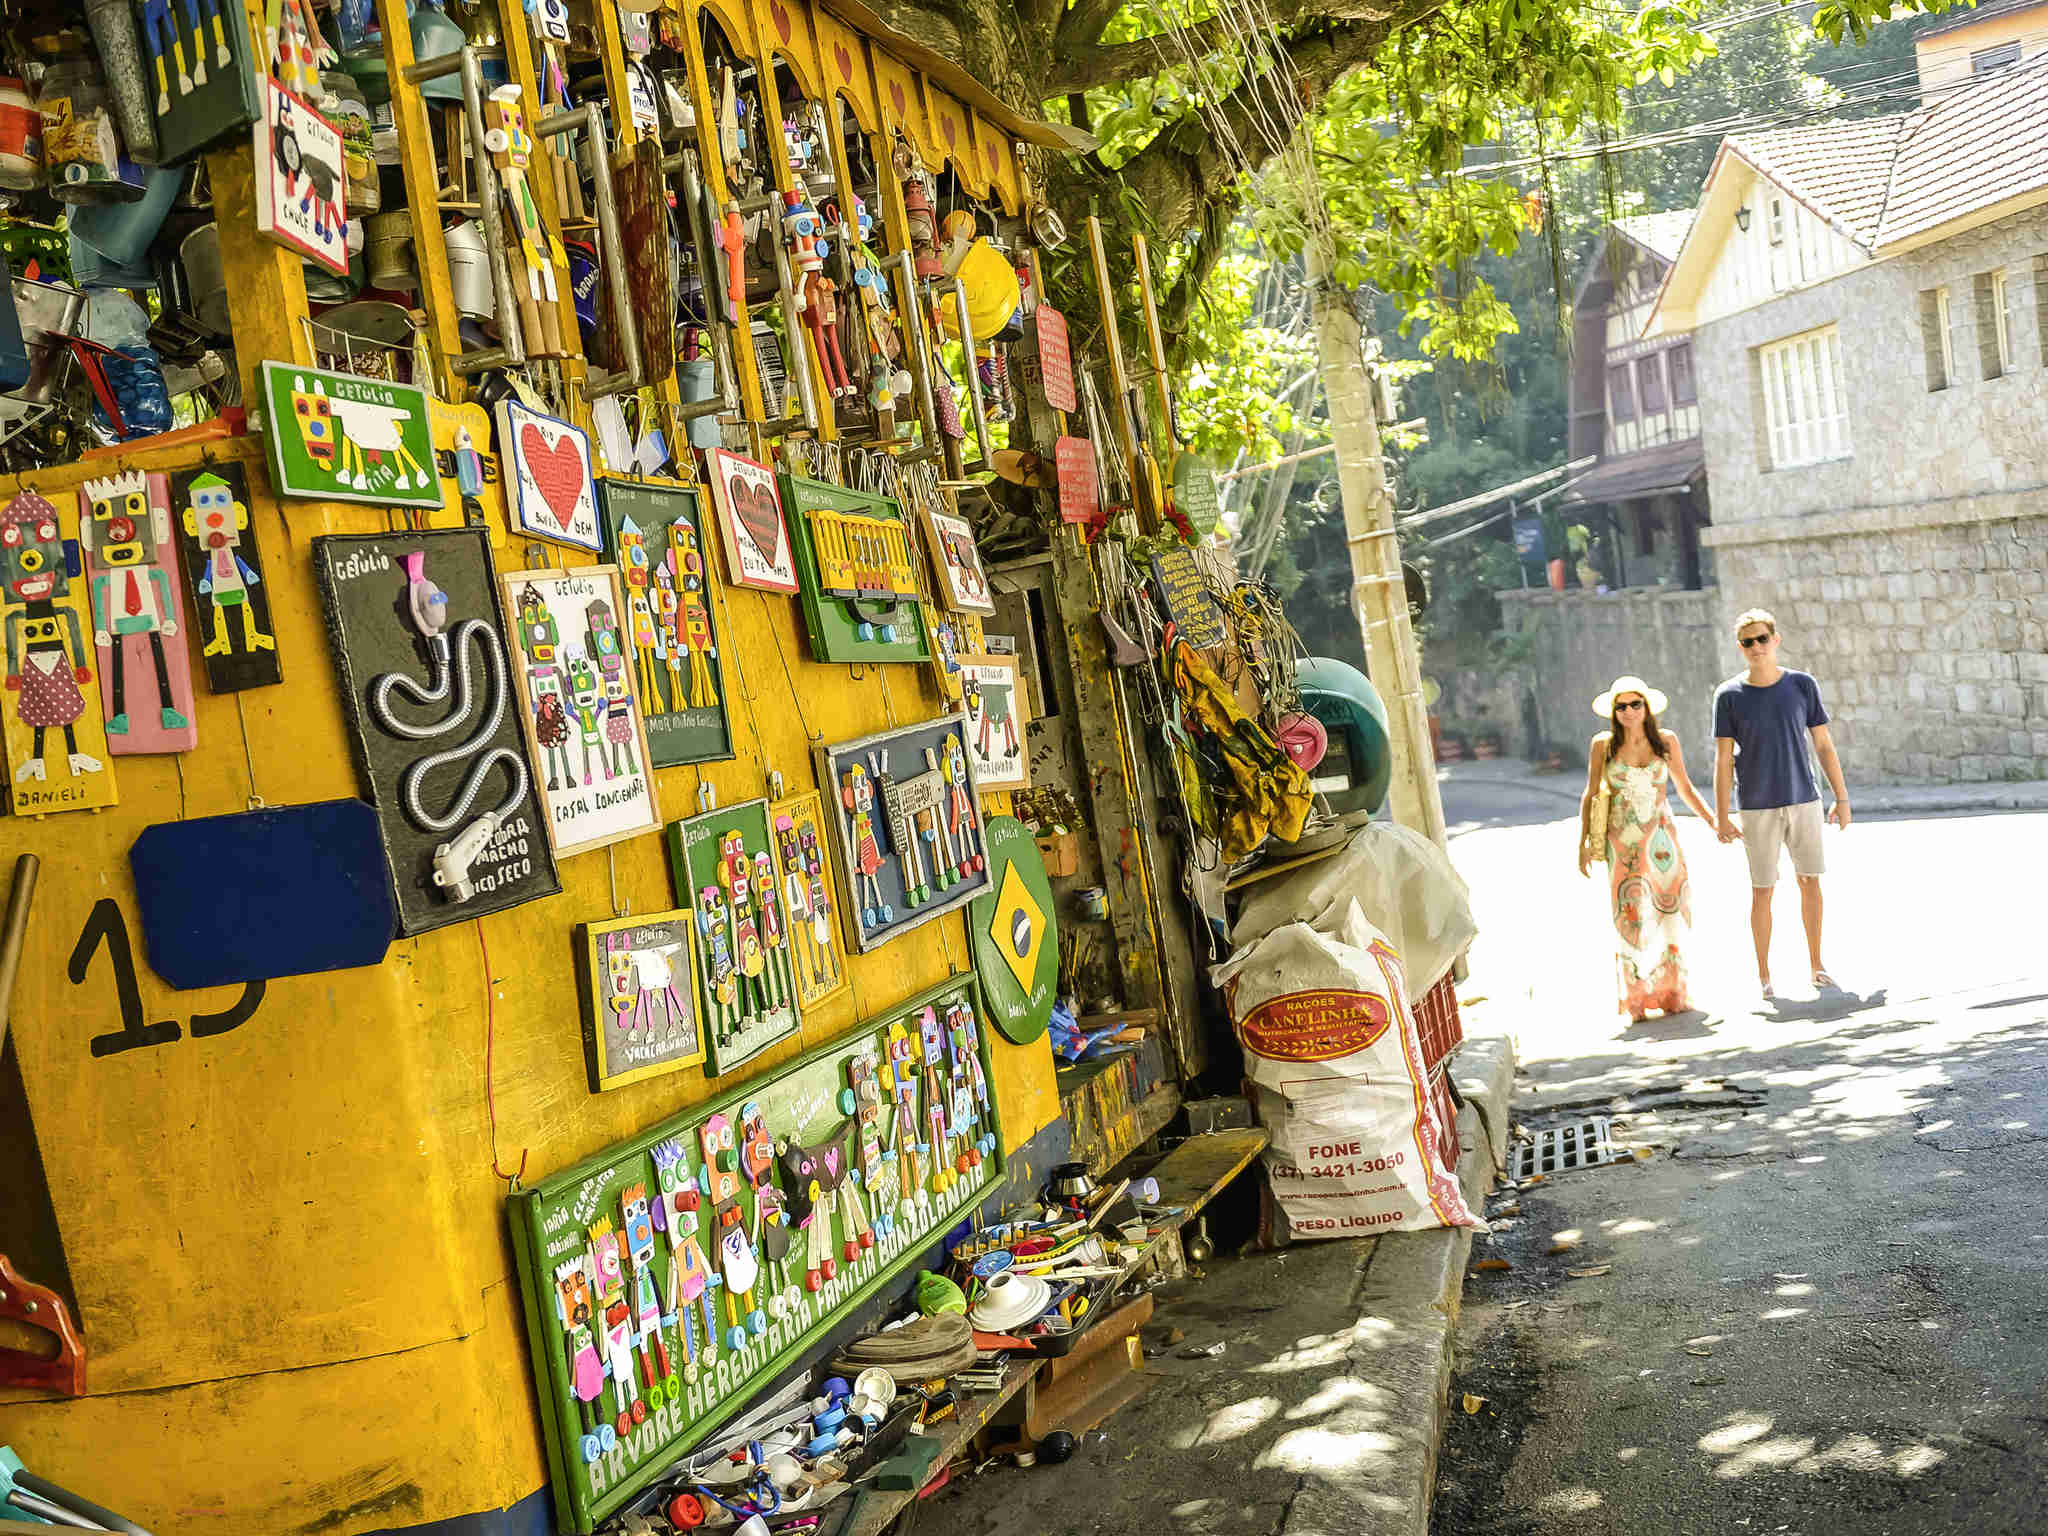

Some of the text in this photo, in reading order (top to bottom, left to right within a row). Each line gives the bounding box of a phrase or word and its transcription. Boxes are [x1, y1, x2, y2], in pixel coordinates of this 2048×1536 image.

[1258, 1003, 1373, 1029] CANELINHA
[1308, 1142, 1362, 1160] FONE
[1272, 1151, 1405, 1181] (37) 3421-3050
[1295, 1211, 1404, 1232] PESO LÍQUIDO
